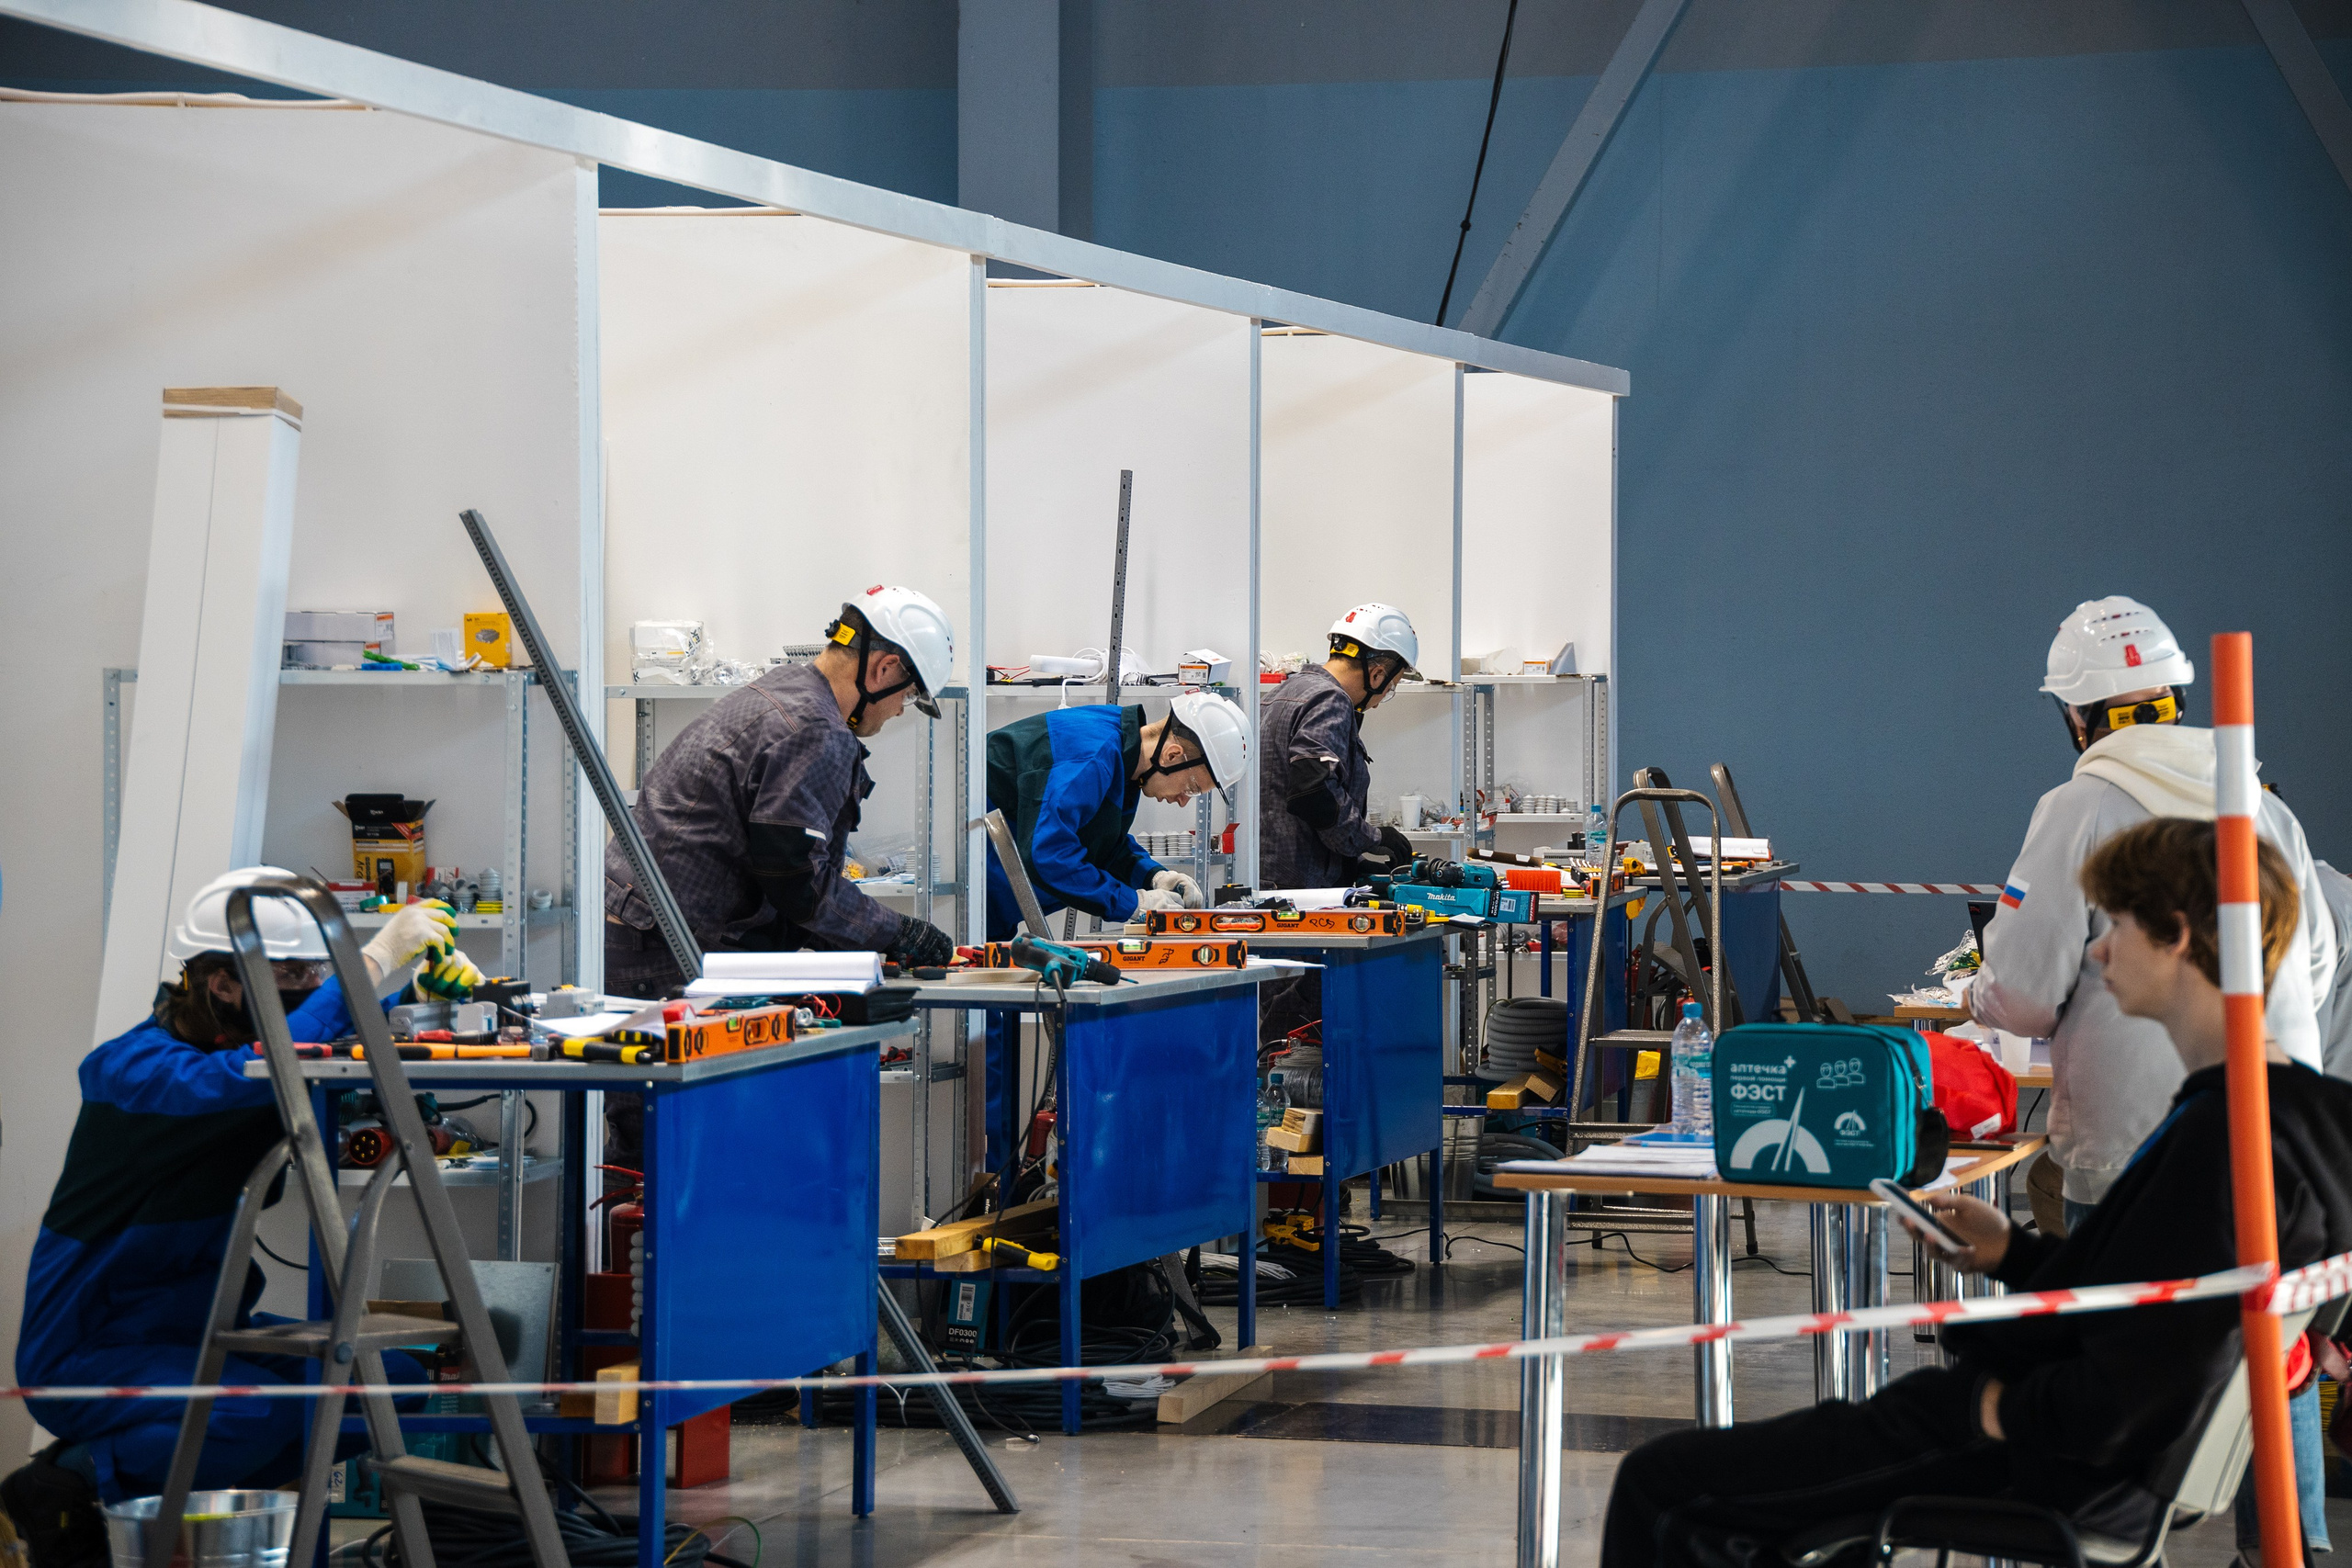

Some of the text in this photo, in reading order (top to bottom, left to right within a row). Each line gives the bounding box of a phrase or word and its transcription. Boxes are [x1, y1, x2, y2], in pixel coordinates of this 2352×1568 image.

[1730, 1063, 1787, 1074] аптечка
[1730, 1082, 1787, 1101] ФЭСТ
[948, 1327, 978, 1337] DF0300
